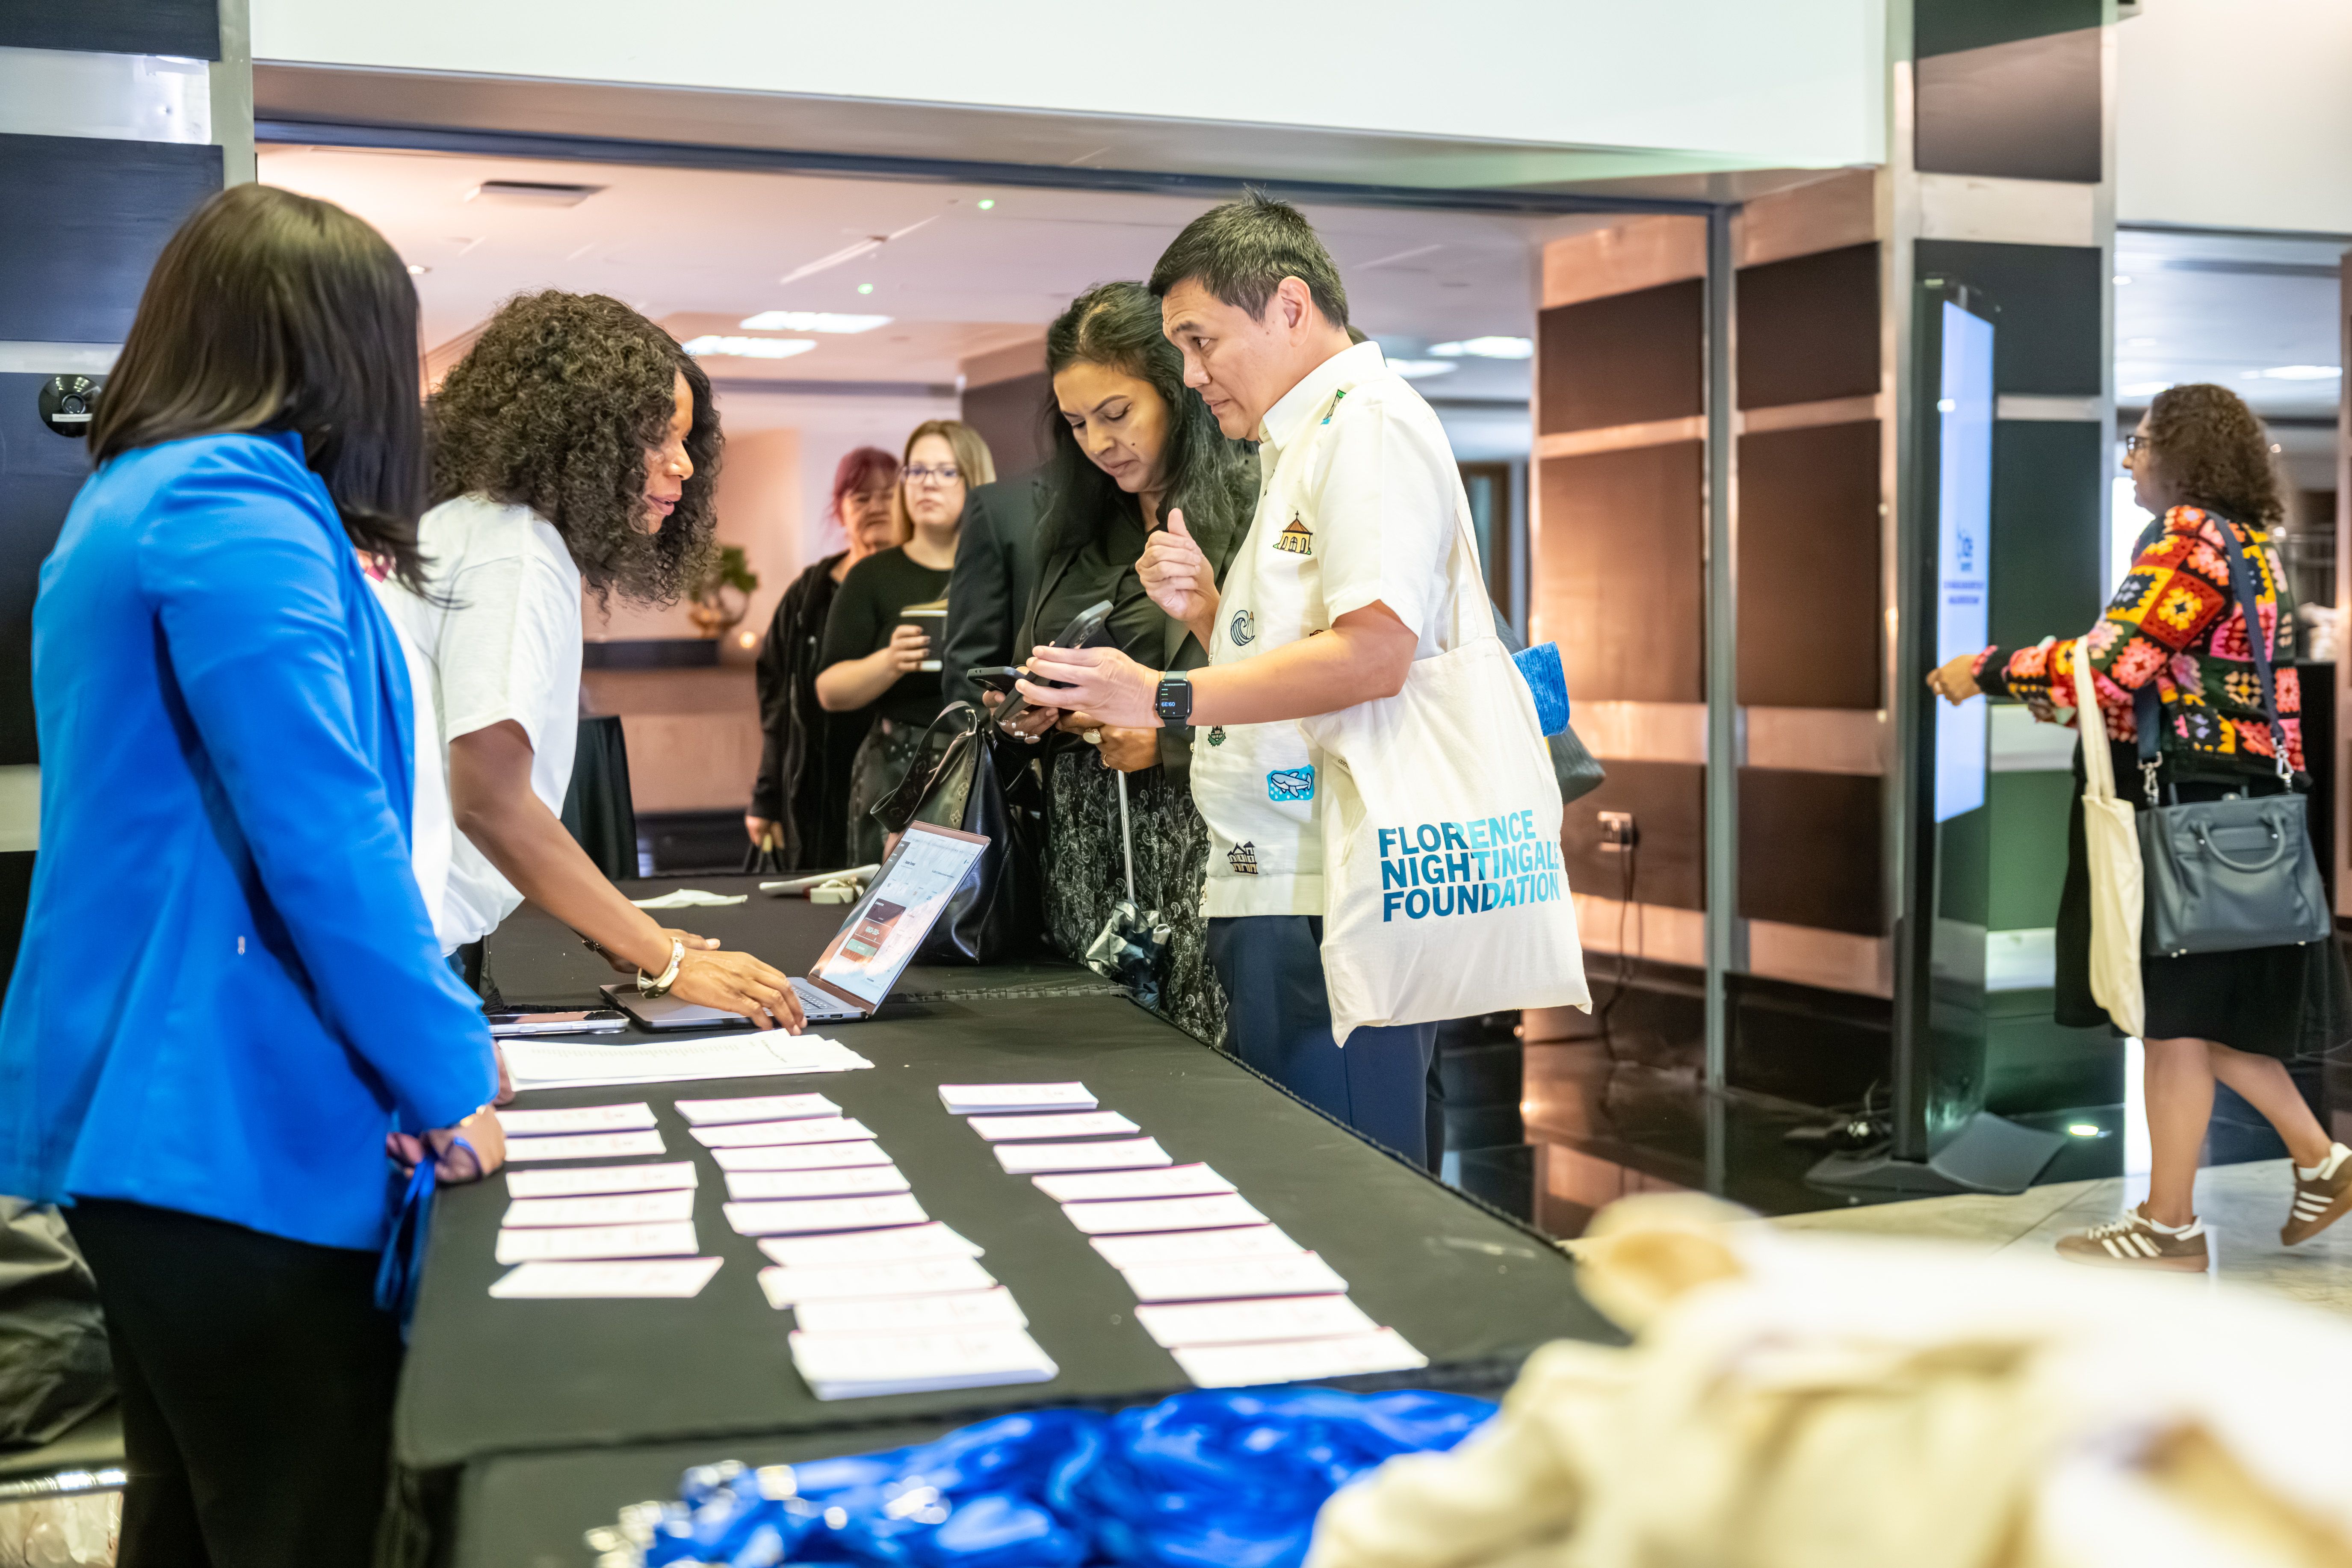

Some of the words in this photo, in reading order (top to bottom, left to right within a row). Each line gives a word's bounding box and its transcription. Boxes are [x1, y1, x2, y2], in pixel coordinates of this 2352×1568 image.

[1378, 809, 1536, 858] FLORENCE
[1380, 841, 1560, 890] NIGHTINGALE
[1383, 872, 1561, 922] FOUNDATION
